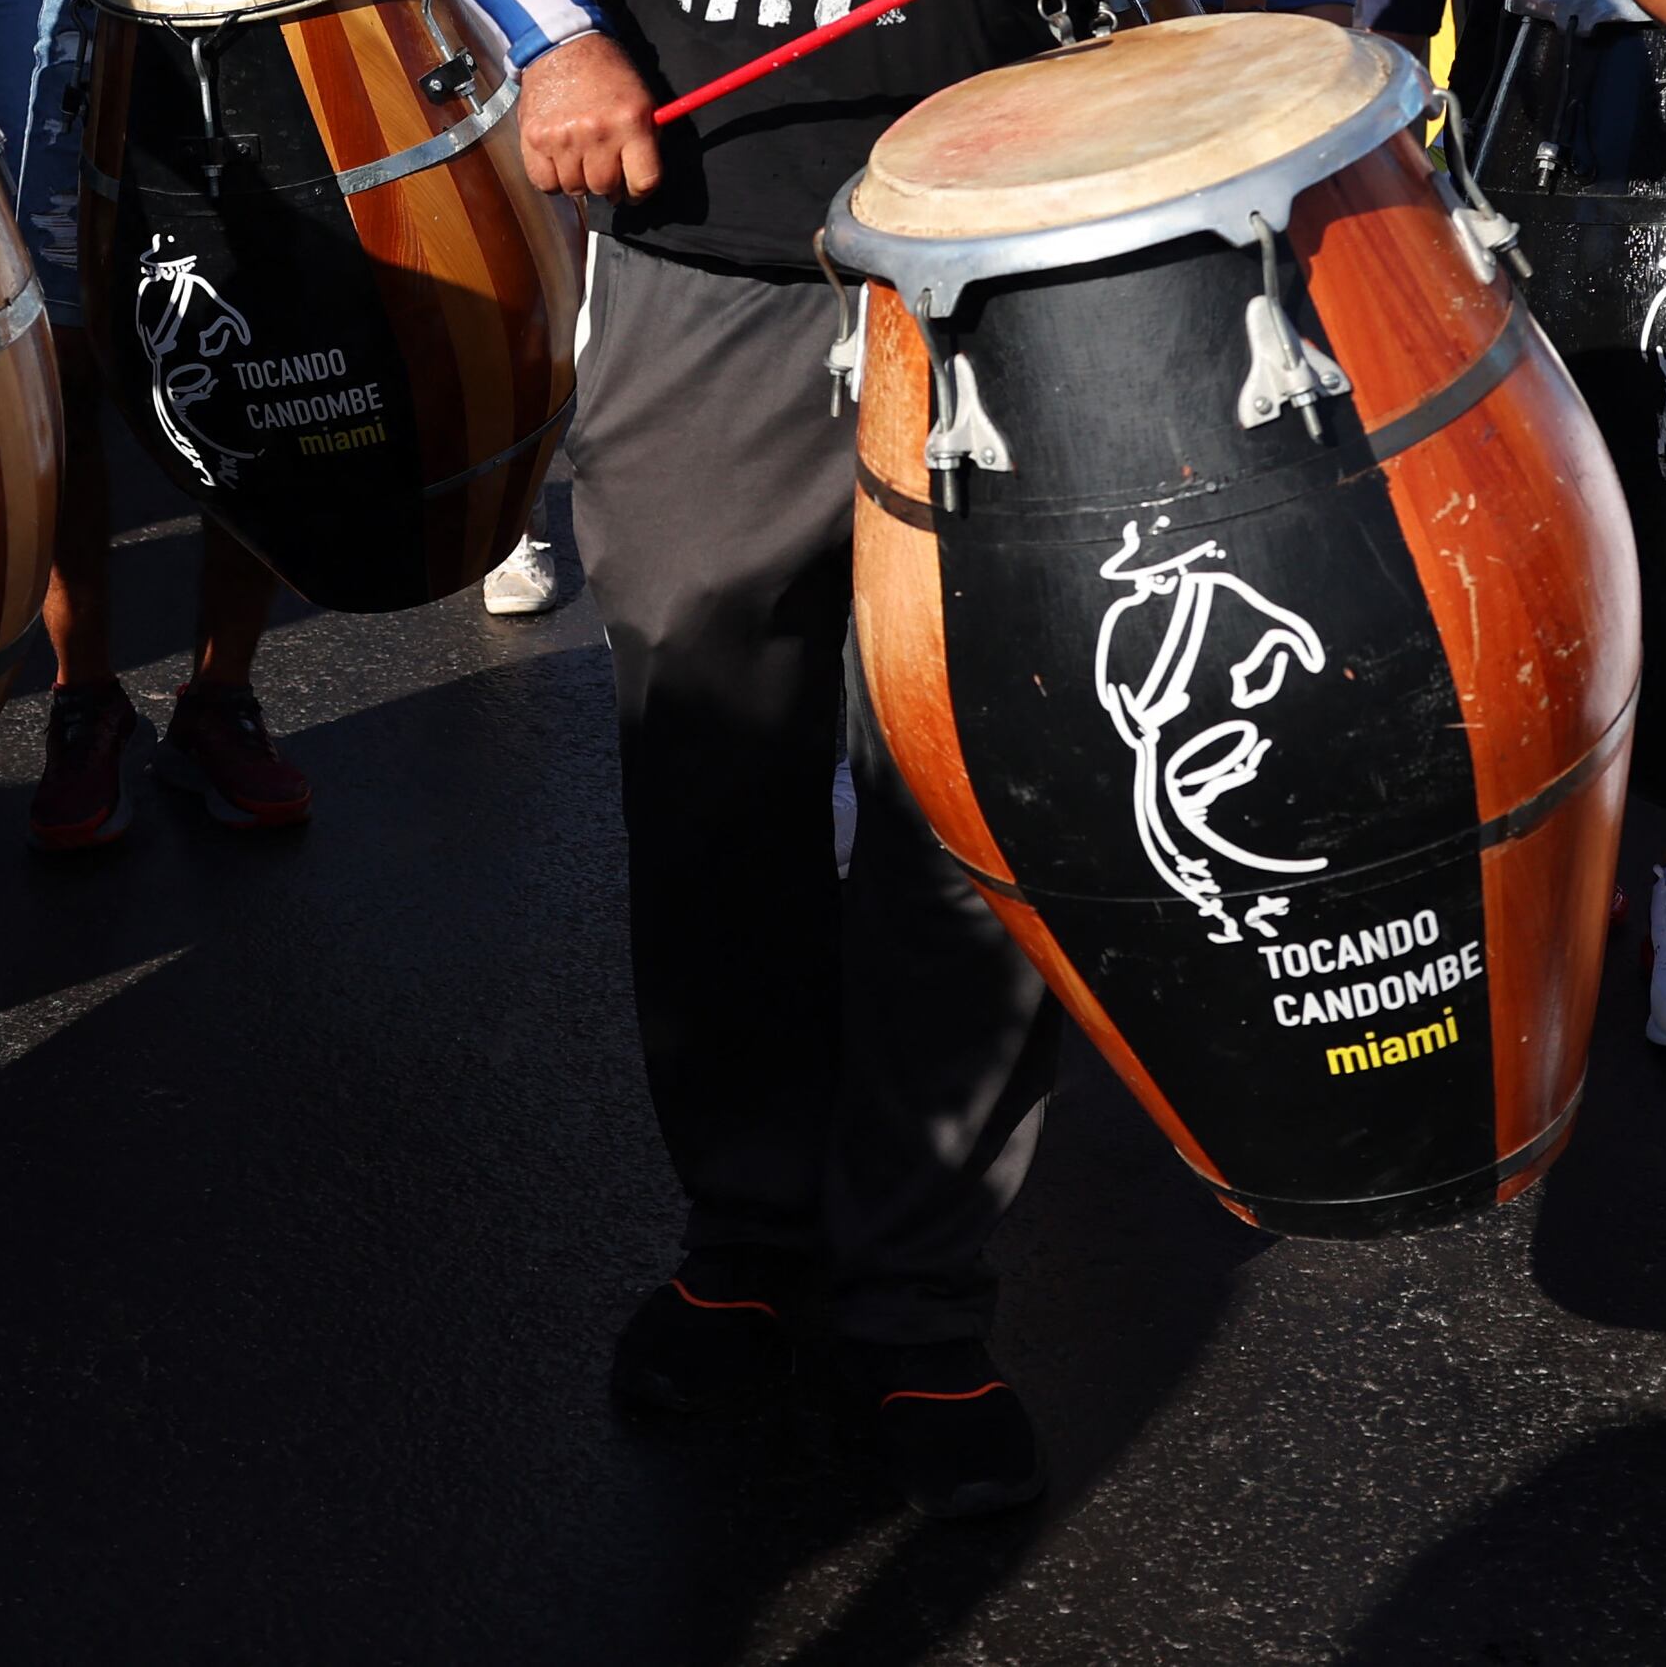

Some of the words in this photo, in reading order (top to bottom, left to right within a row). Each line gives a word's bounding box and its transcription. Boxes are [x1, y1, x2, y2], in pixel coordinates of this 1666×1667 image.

[232, 348, 347, 390] TOCANDO
[246, 383, 383, 430] CANDOMBE
[298, 416, 386, 455] miami
[1258, 909, 1440, 980] TOCANDO
[1273, 940, 1484, 1028] CANDOMBE
[1326, 1006, 1459, 1076] miami
